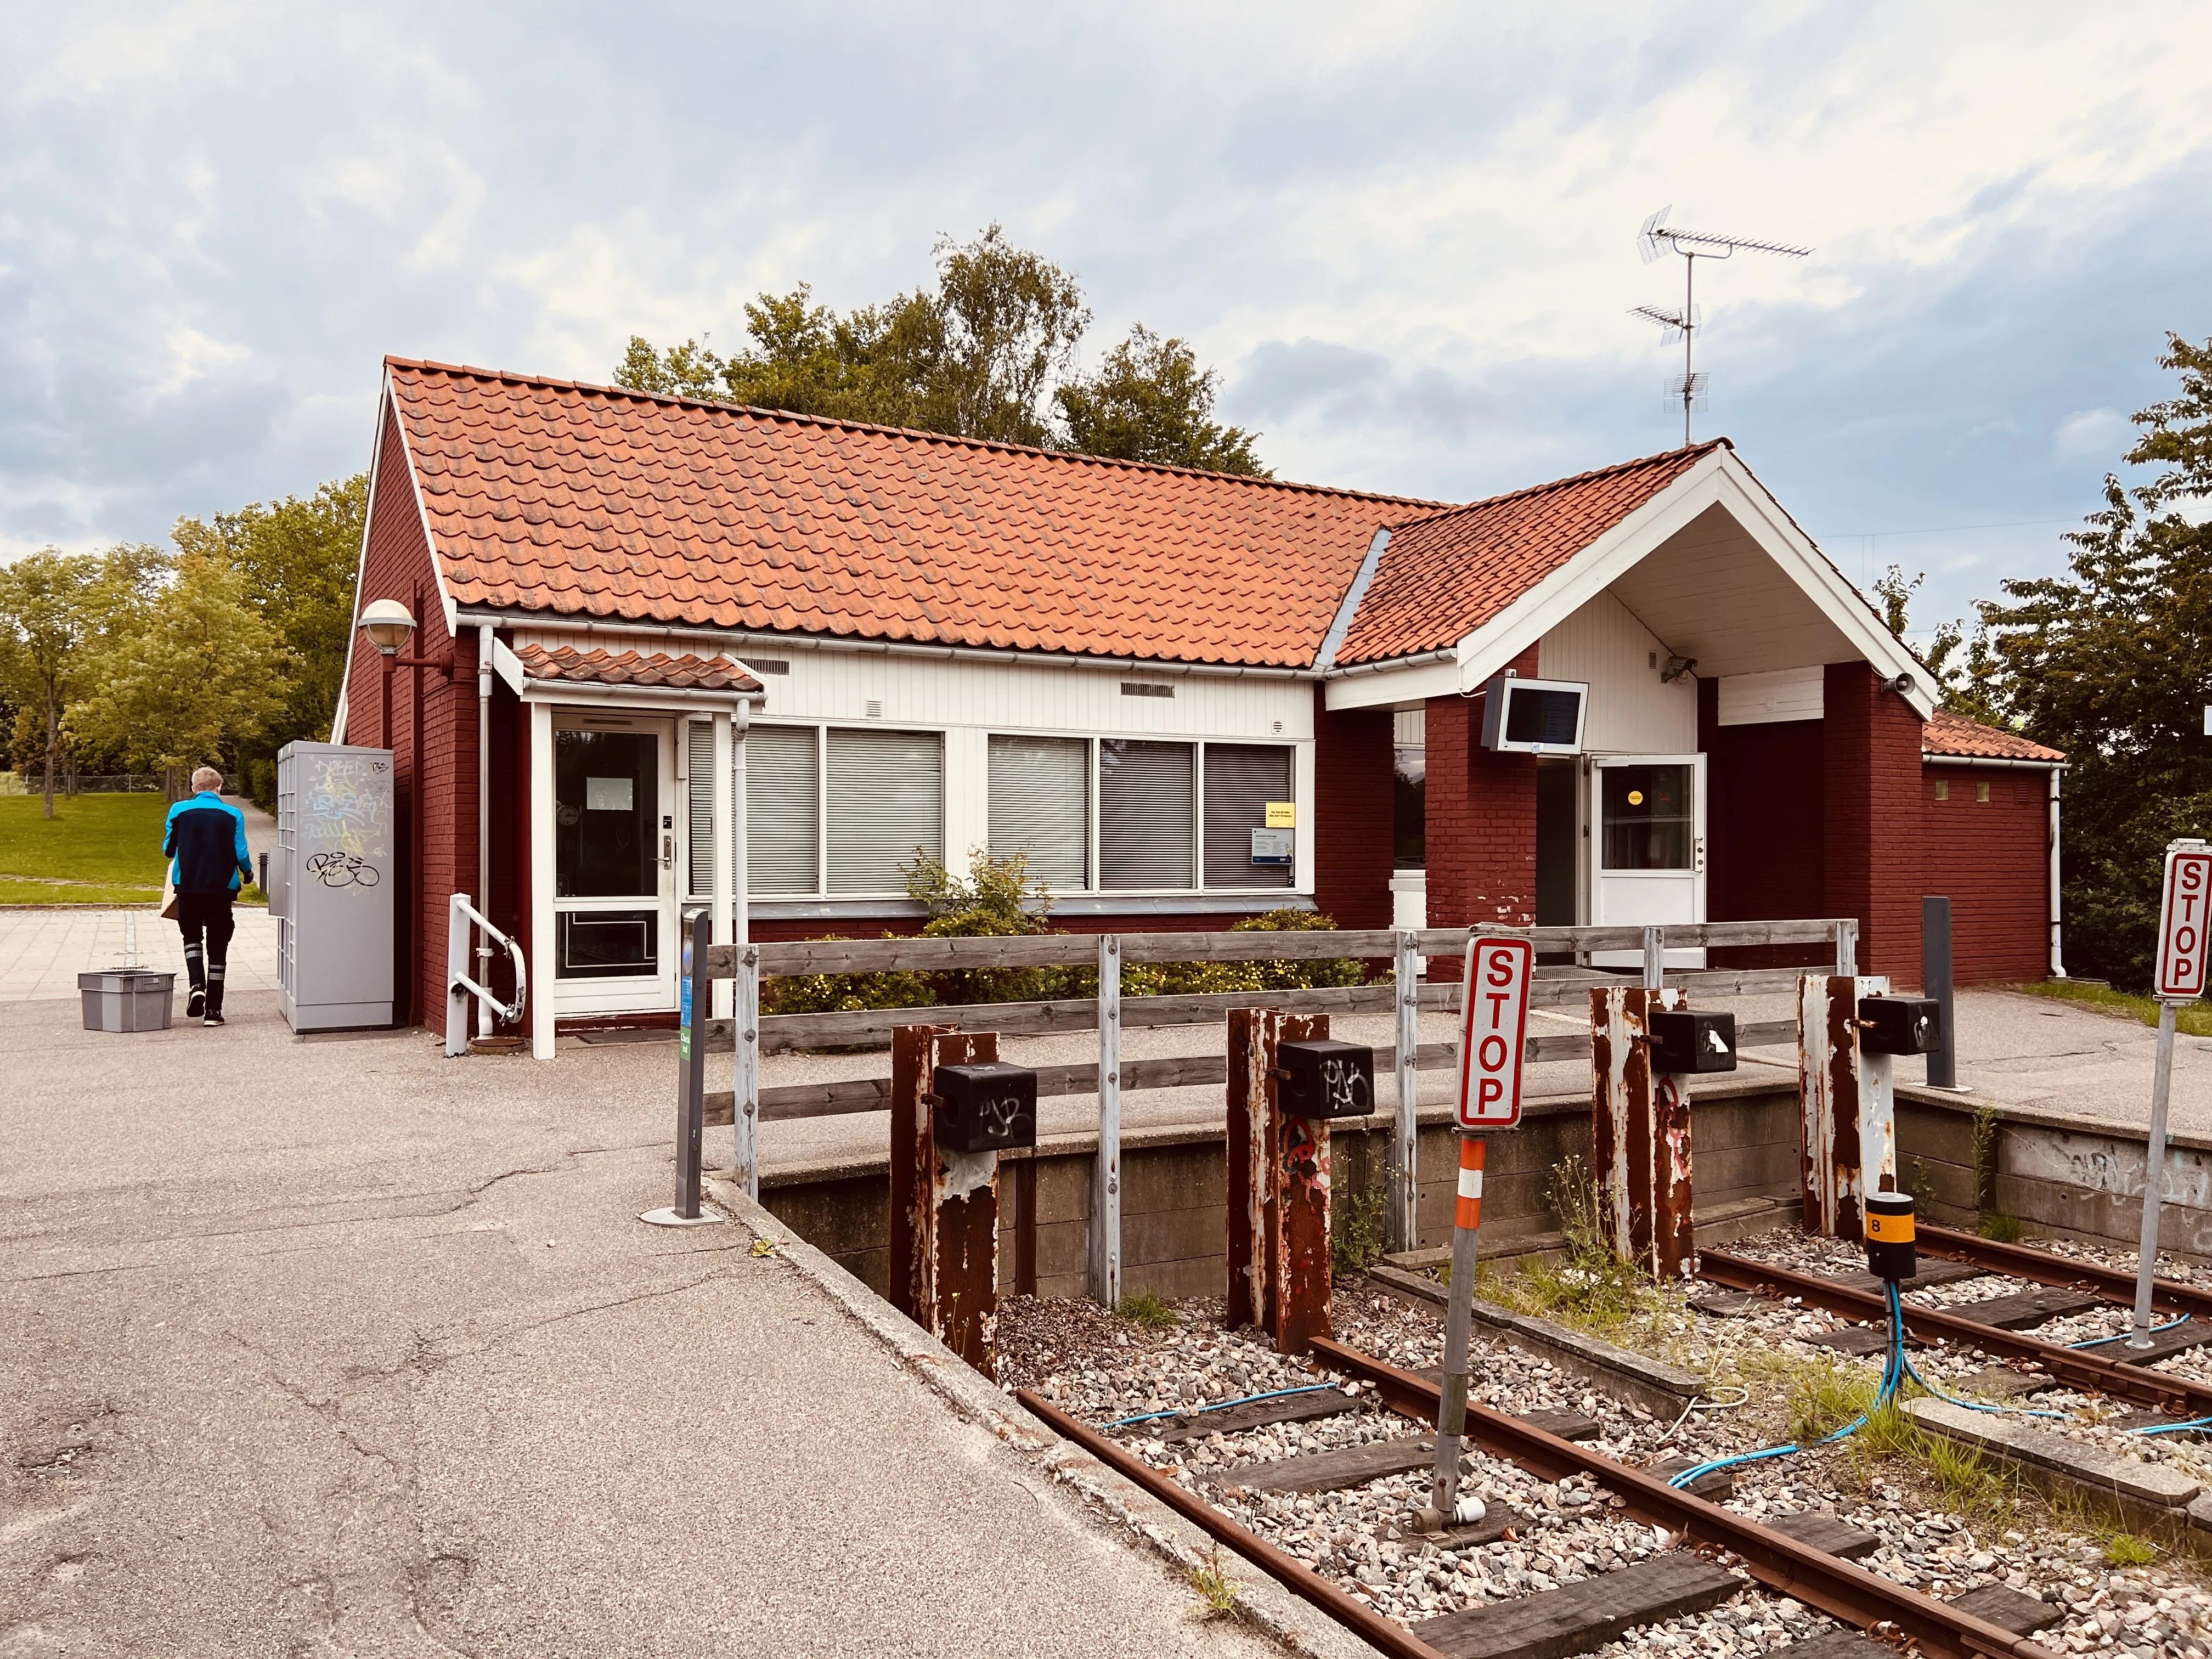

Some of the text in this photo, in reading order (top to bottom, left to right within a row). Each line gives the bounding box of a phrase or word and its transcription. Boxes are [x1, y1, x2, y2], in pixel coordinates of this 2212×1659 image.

[2174, 862, 2201, 985] STOP
[1478, 950, 1514, 1115] STOP
[1871, 1219, 1881, 1233] 8
